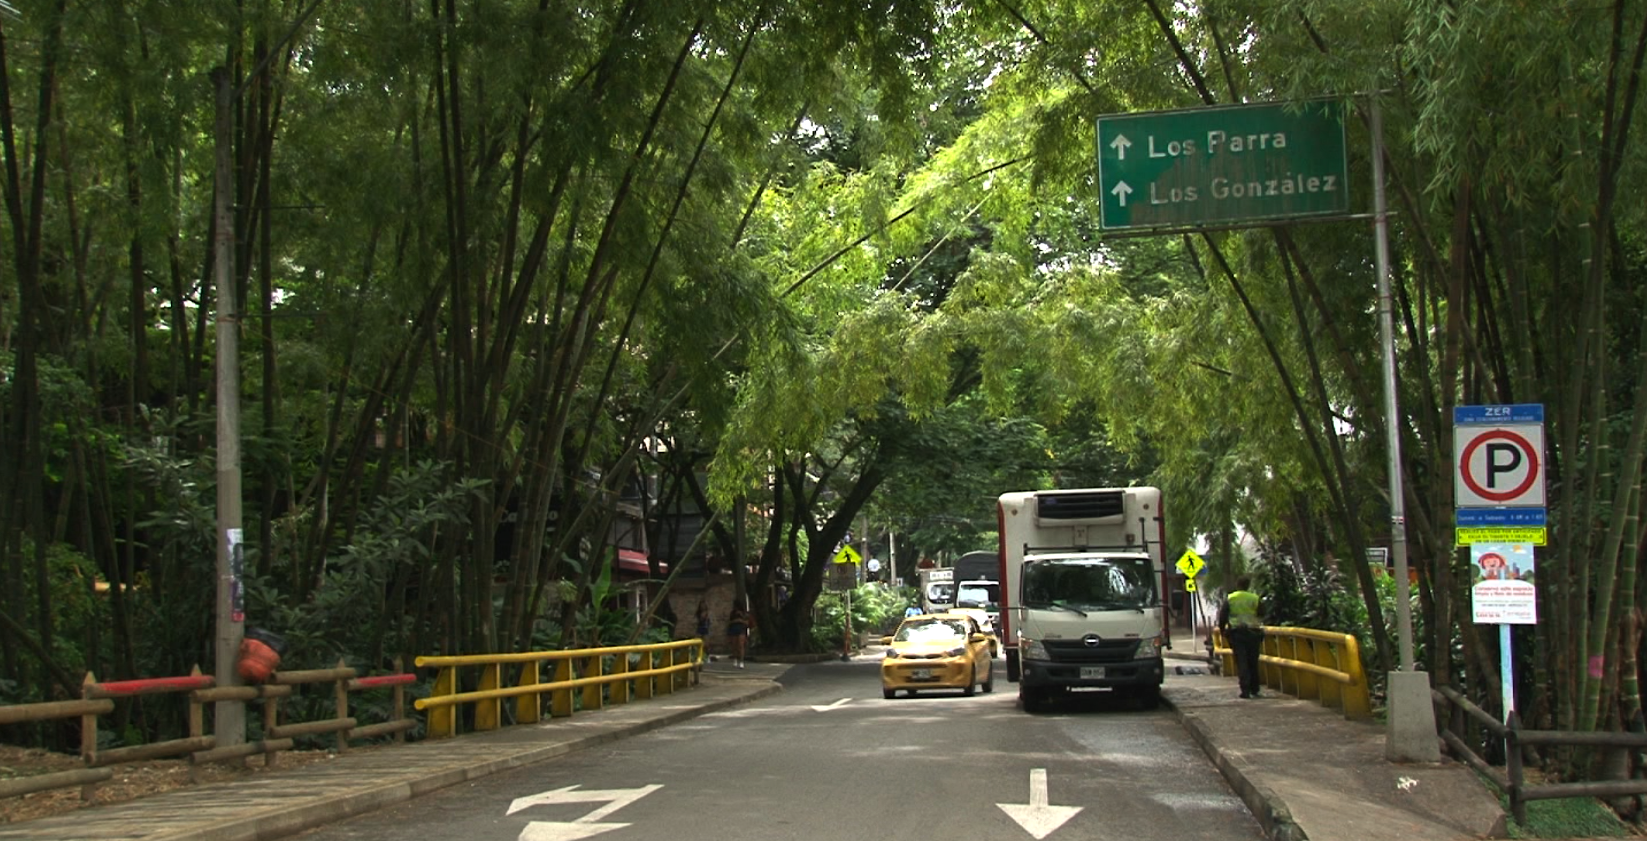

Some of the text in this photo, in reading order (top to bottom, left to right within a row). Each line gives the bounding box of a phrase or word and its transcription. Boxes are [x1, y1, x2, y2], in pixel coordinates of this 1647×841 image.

[1148, 130, 1287, 158] Los Parra
[1150, 171, 1338, 205] Los González
[1485, 407, 1511, 416] ZER
[1485, 442, 1522, 489] P
